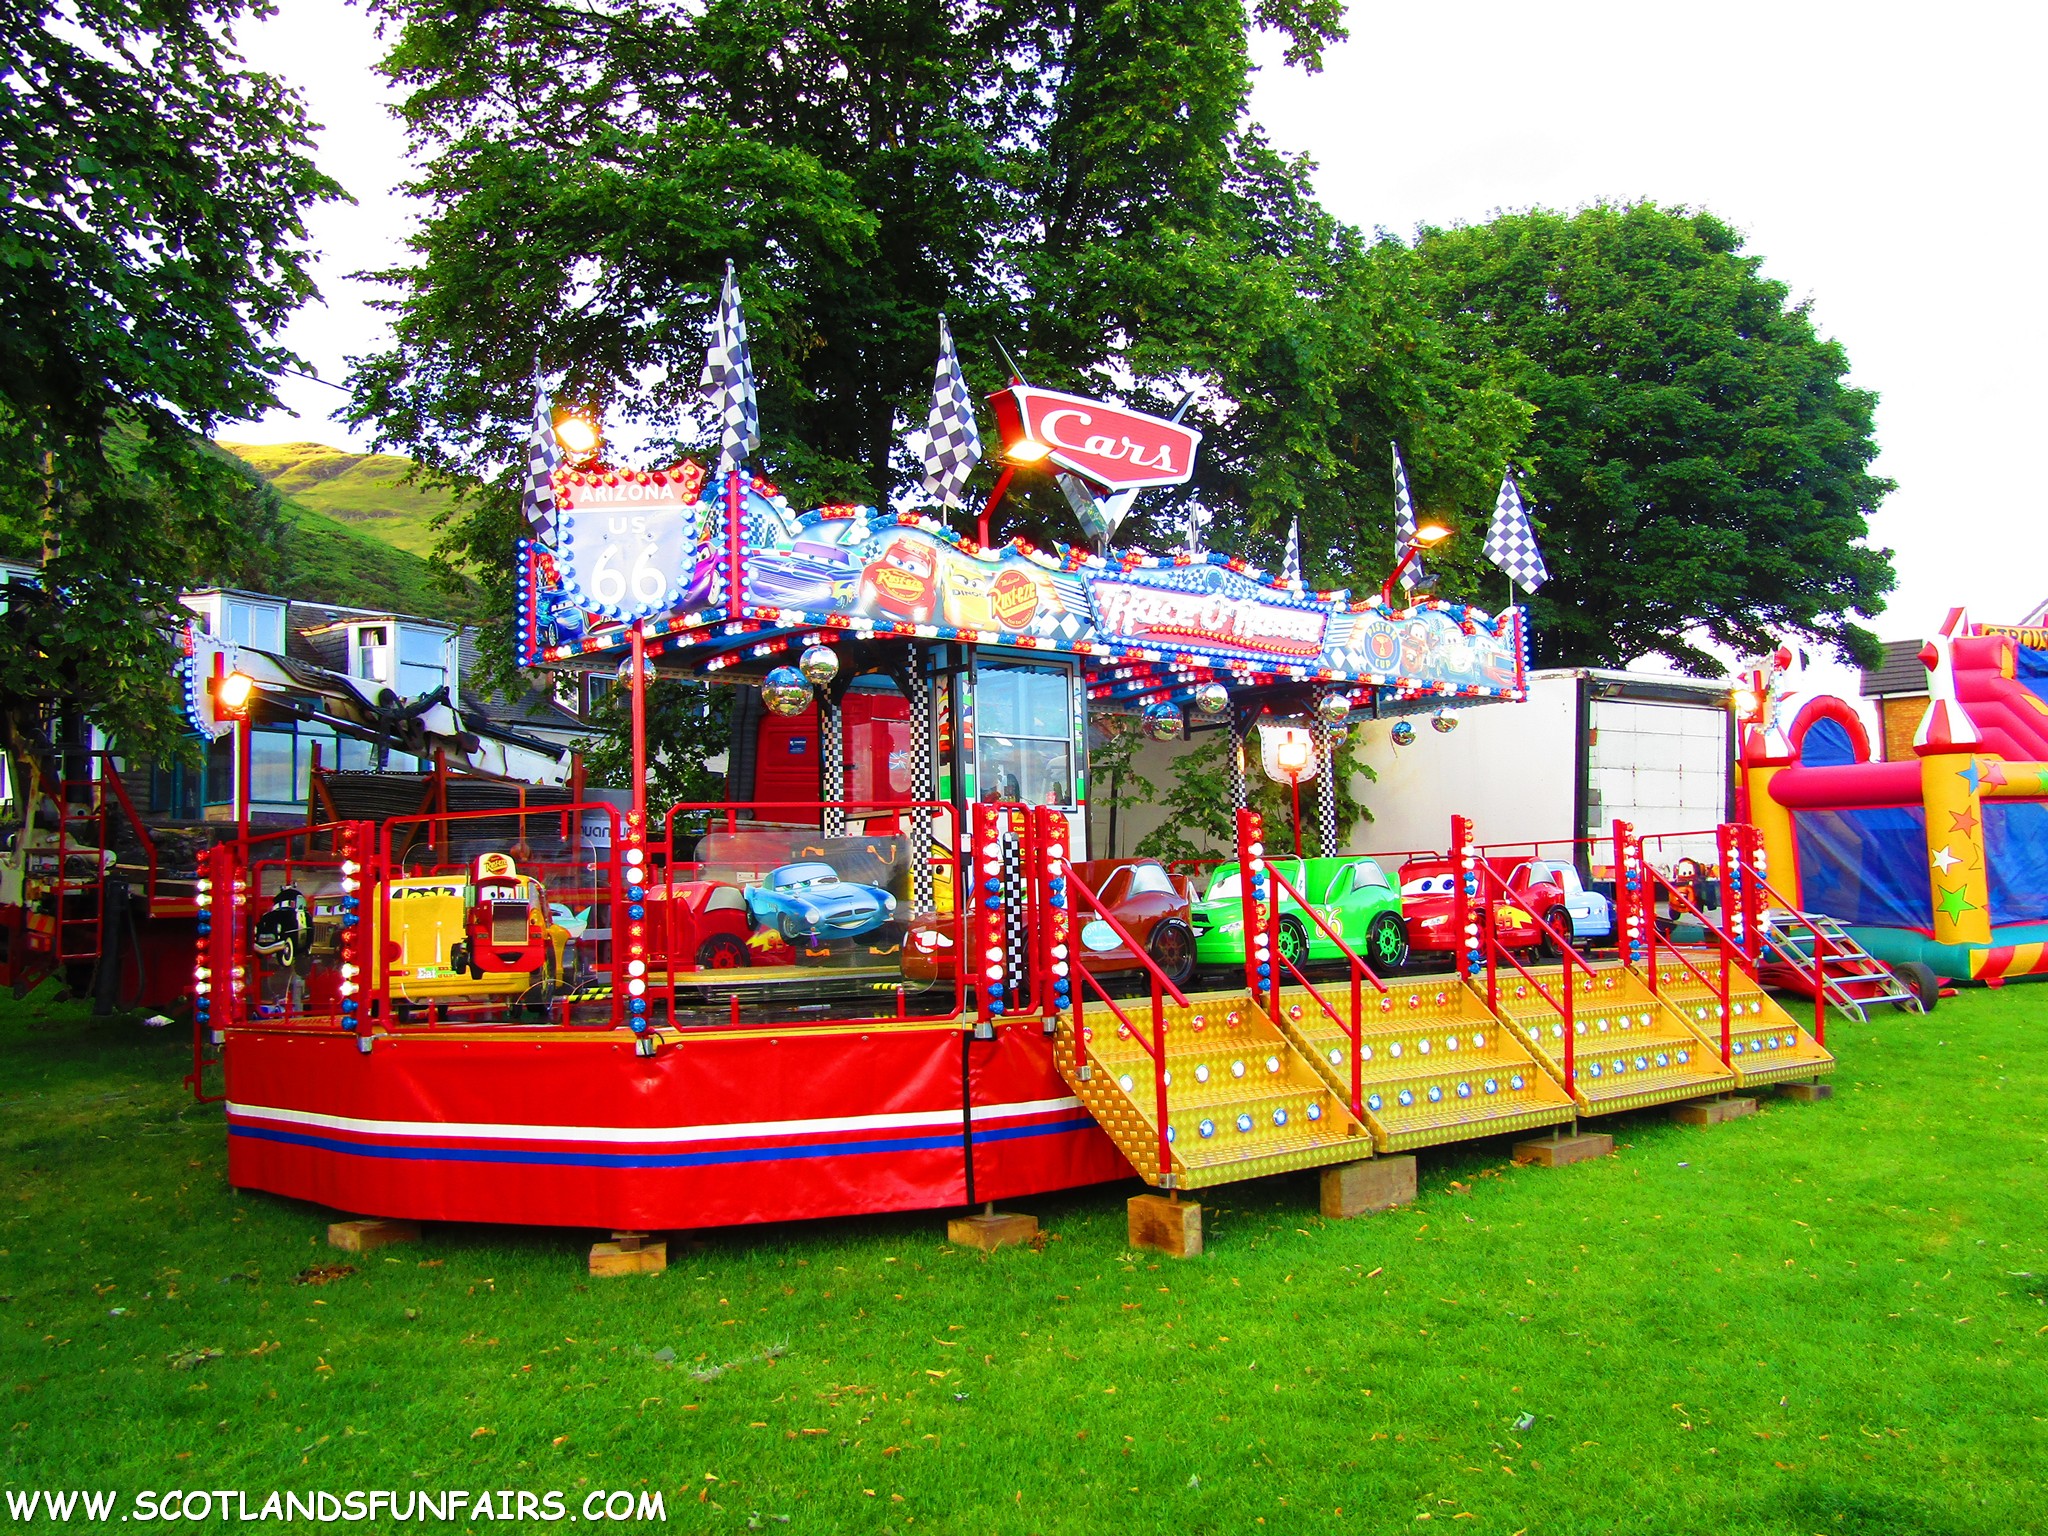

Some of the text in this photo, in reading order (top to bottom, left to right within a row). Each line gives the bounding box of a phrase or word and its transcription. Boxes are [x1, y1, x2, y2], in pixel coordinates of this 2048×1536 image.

[1040, 409, 1179, 474] Cars
[579, 483, 675, 502] ARIZONA
[608, 516, 647, 535] US
[591, 542, 667, 605] 66
[1366, 622, 1398, 641] PISTON
[1375, 658, 1391, 669] CUP
[1315, 908, 1342, 939] 86
